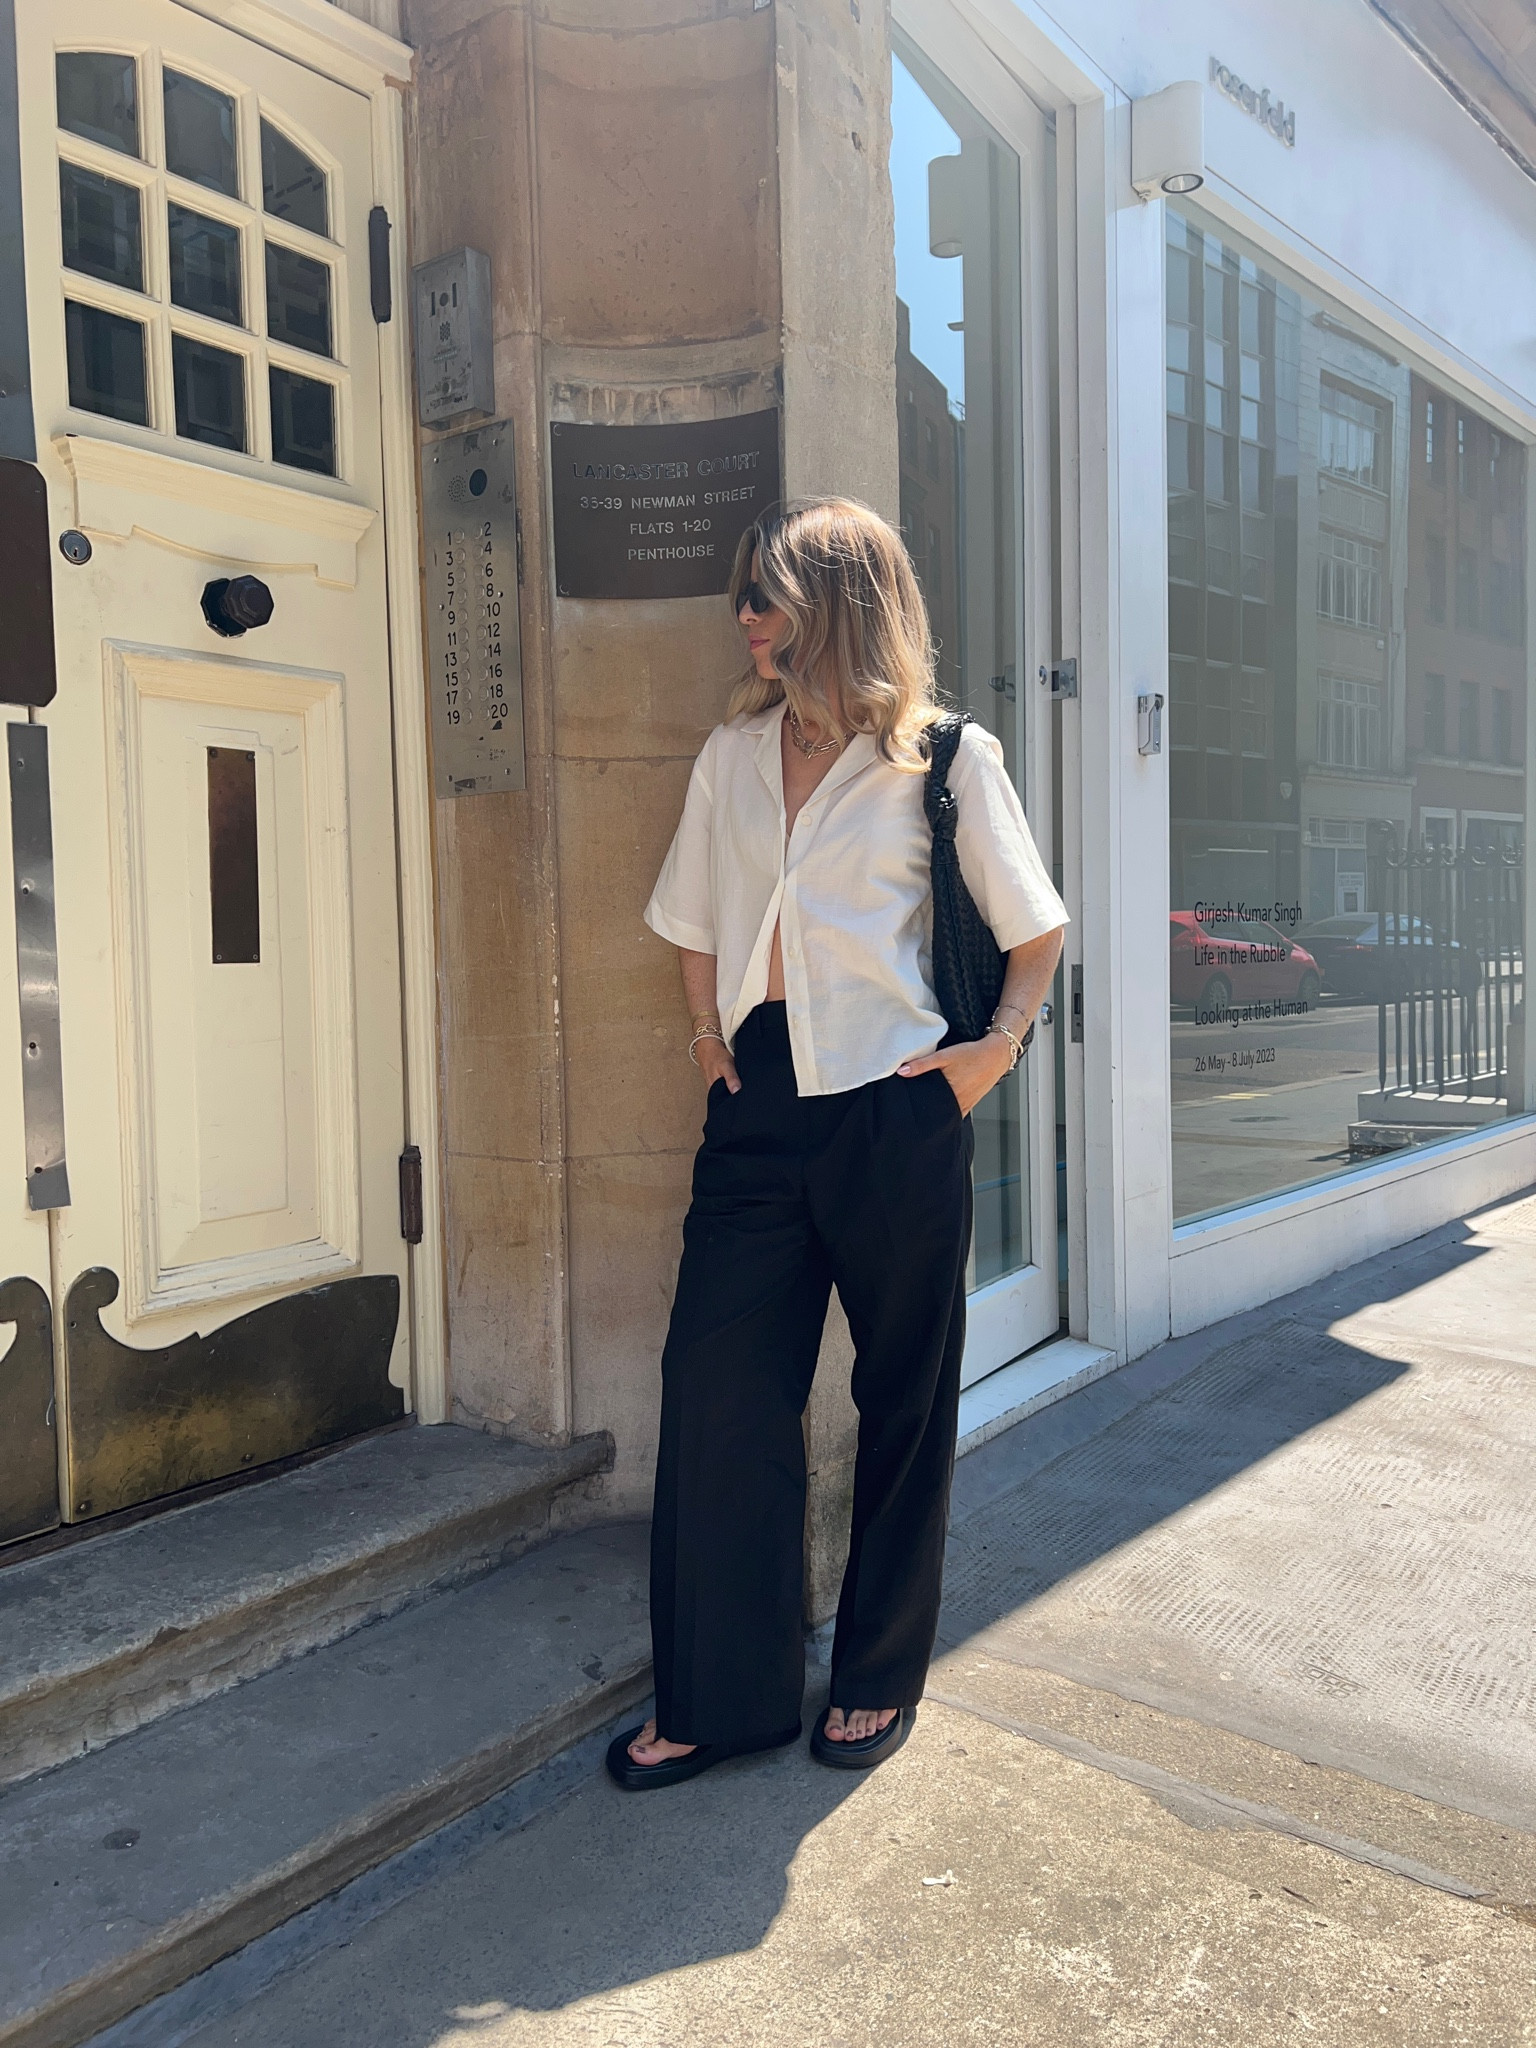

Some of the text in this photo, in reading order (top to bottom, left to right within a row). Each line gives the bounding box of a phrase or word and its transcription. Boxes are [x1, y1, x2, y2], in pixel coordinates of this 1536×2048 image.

[574, 451, 760, 481] LANCASTER COURT
[580, 486, 755, 509] 35-39 NEWMAN STREET
[484, 522, 491, 536] 2
[630, 519, 711, 534] FLATS 1-20
[448, 532, 451, 545] 1
[485, 541, 492, 554] 4
[628, 545, 715, 560] PENTHOUSE
[446, 552, 453, 565] 3
[485, 563, 493, 576] 6
[447, 573, 454, 586] 5
[486, 584, 493, 597] 8
[448, 592, 454, 605] 7
[487, 602, 500, 617] 10
[448, 611, 455, 624] 9
[487, 623, 500, 638] 12
[448, 632, 456, 646] 11
[488, 643, 501, 657] 14
[445, 652, 457, 667] 13
[489, 663, 502, 678] 16
[446, 672, 458, 687] 15
[447, 691, 458, 705] 17
[490, 684, 503, 698] 18
[448, 710, 460, 724] 19
[491, 703, 508, 718] 20
[1195, 901, 1302, 928] Girjesh Kumar Singh
[1195, 943, 1285, 965] Life in the Rubble
[1195, 999, 1307, 1028] Looking at the Human
[1195, 1057, 1206, 1072] 26
[1209, 1056, 1226, 1072] May
[1233, 1053, 1237, 1067] 8
[1239, 1050, 1254, 1069] July
[1256, 1048, 1275, 1063] 2023
